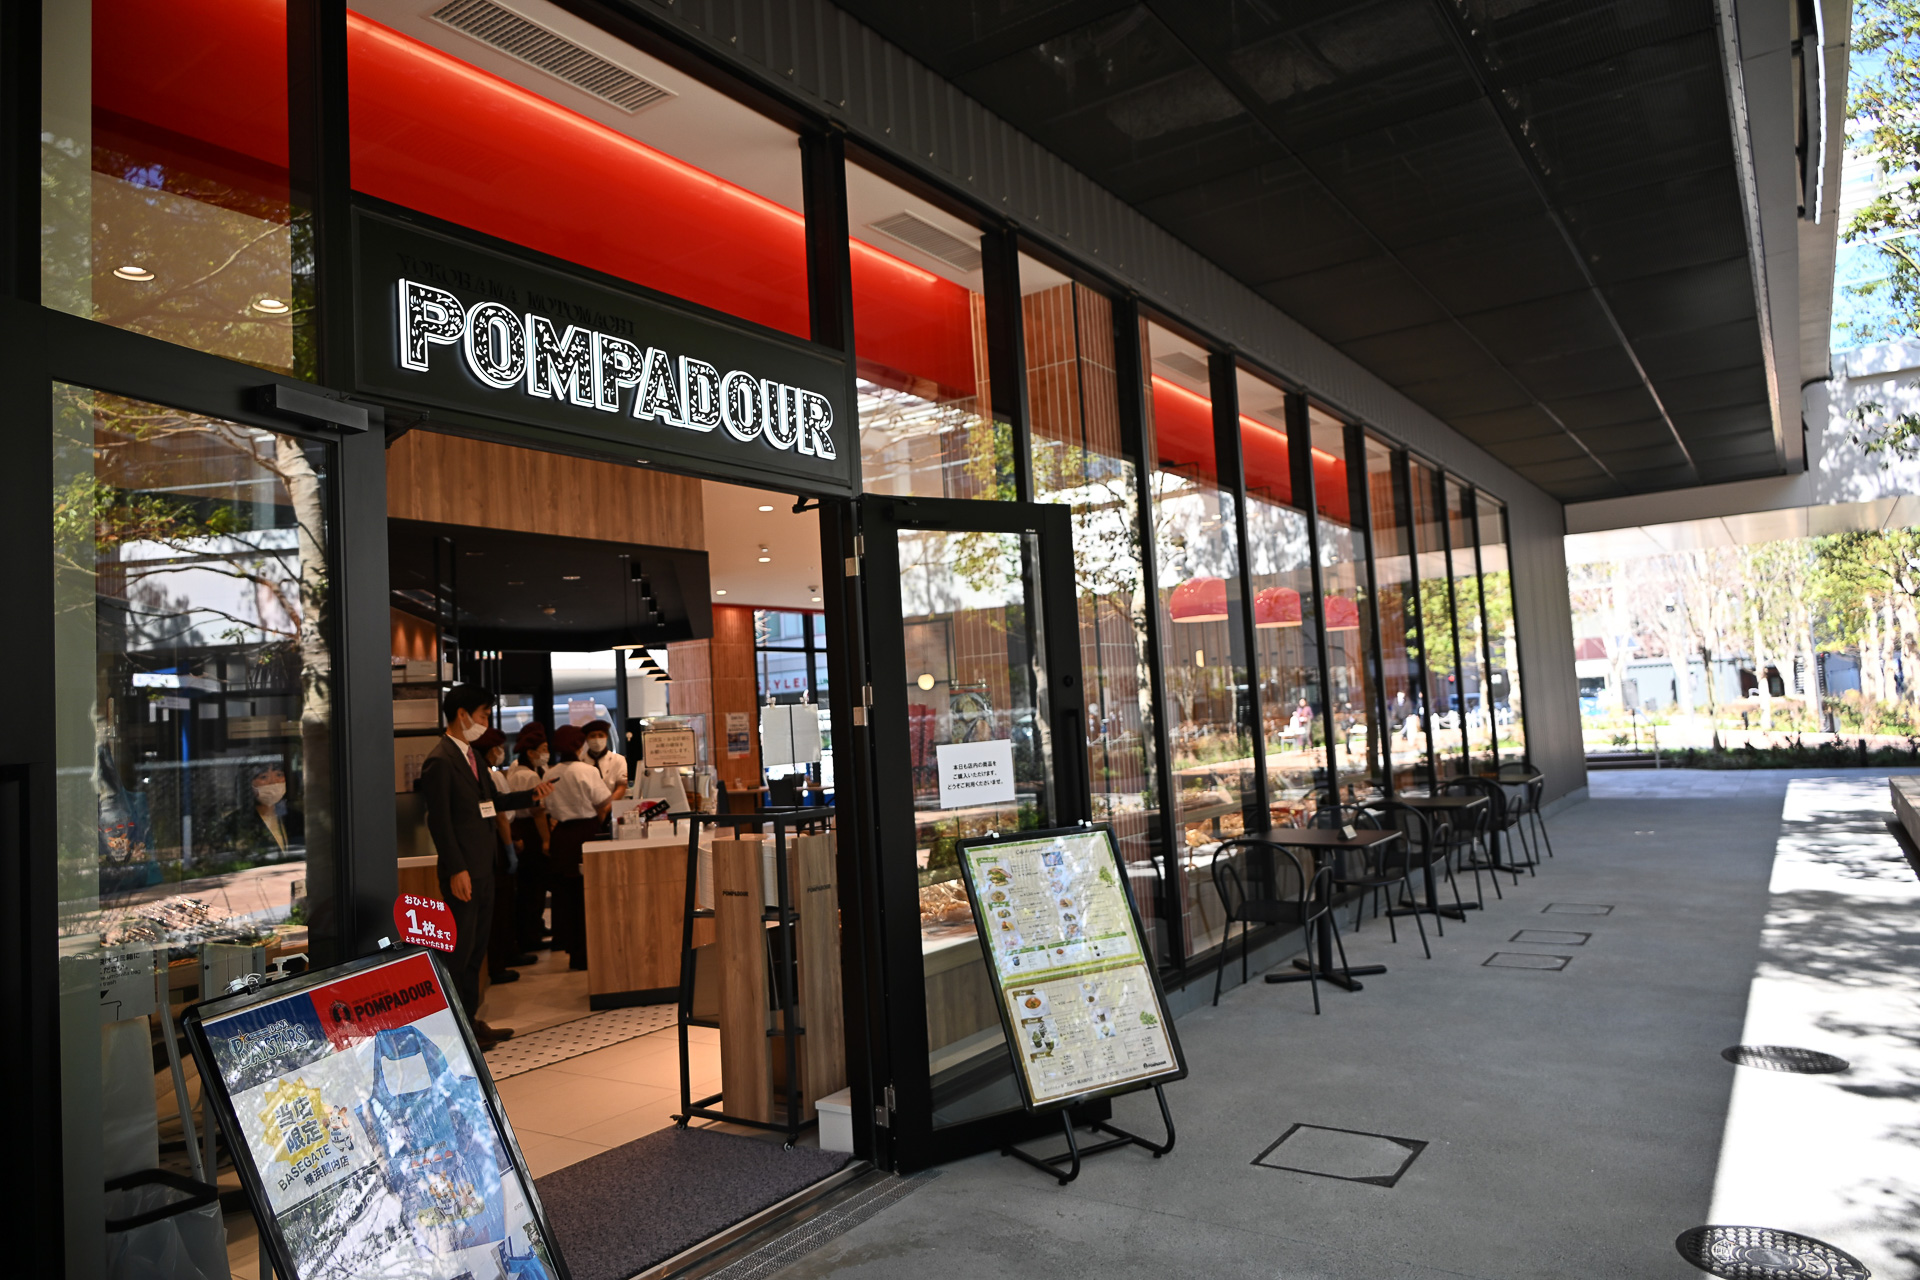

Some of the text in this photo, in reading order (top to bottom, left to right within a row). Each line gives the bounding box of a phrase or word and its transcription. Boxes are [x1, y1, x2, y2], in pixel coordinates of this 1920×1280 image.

[397, 252, 636, 337] YOKOHAMA MOTOMACHI
[398, 277, 837, 460] POMPADOUR
[953, 761, 997, 770] 本日も店内の商品を
[953, 770, 997, 780] ご購入いただけます。
[947, 779, 1003, 790] どうぞご利用くださいませ。
[404, 895, 445, 911] おひとり様
[405, 909, 451, 941] 1枚まで
[405, 936, 454, 951] とさせていただきます
[353, 980, 436, 1022] POMPADOUR
[229, 1024, 309, 1070] BAYSTARS
[275, 1096, 314, 1129] 当店
[283, 1119, 324, 1155] 限定
[277, 1144, 332, 1191] BASEGATE
[303, 1155, 350, 1187] 横浜関内店
